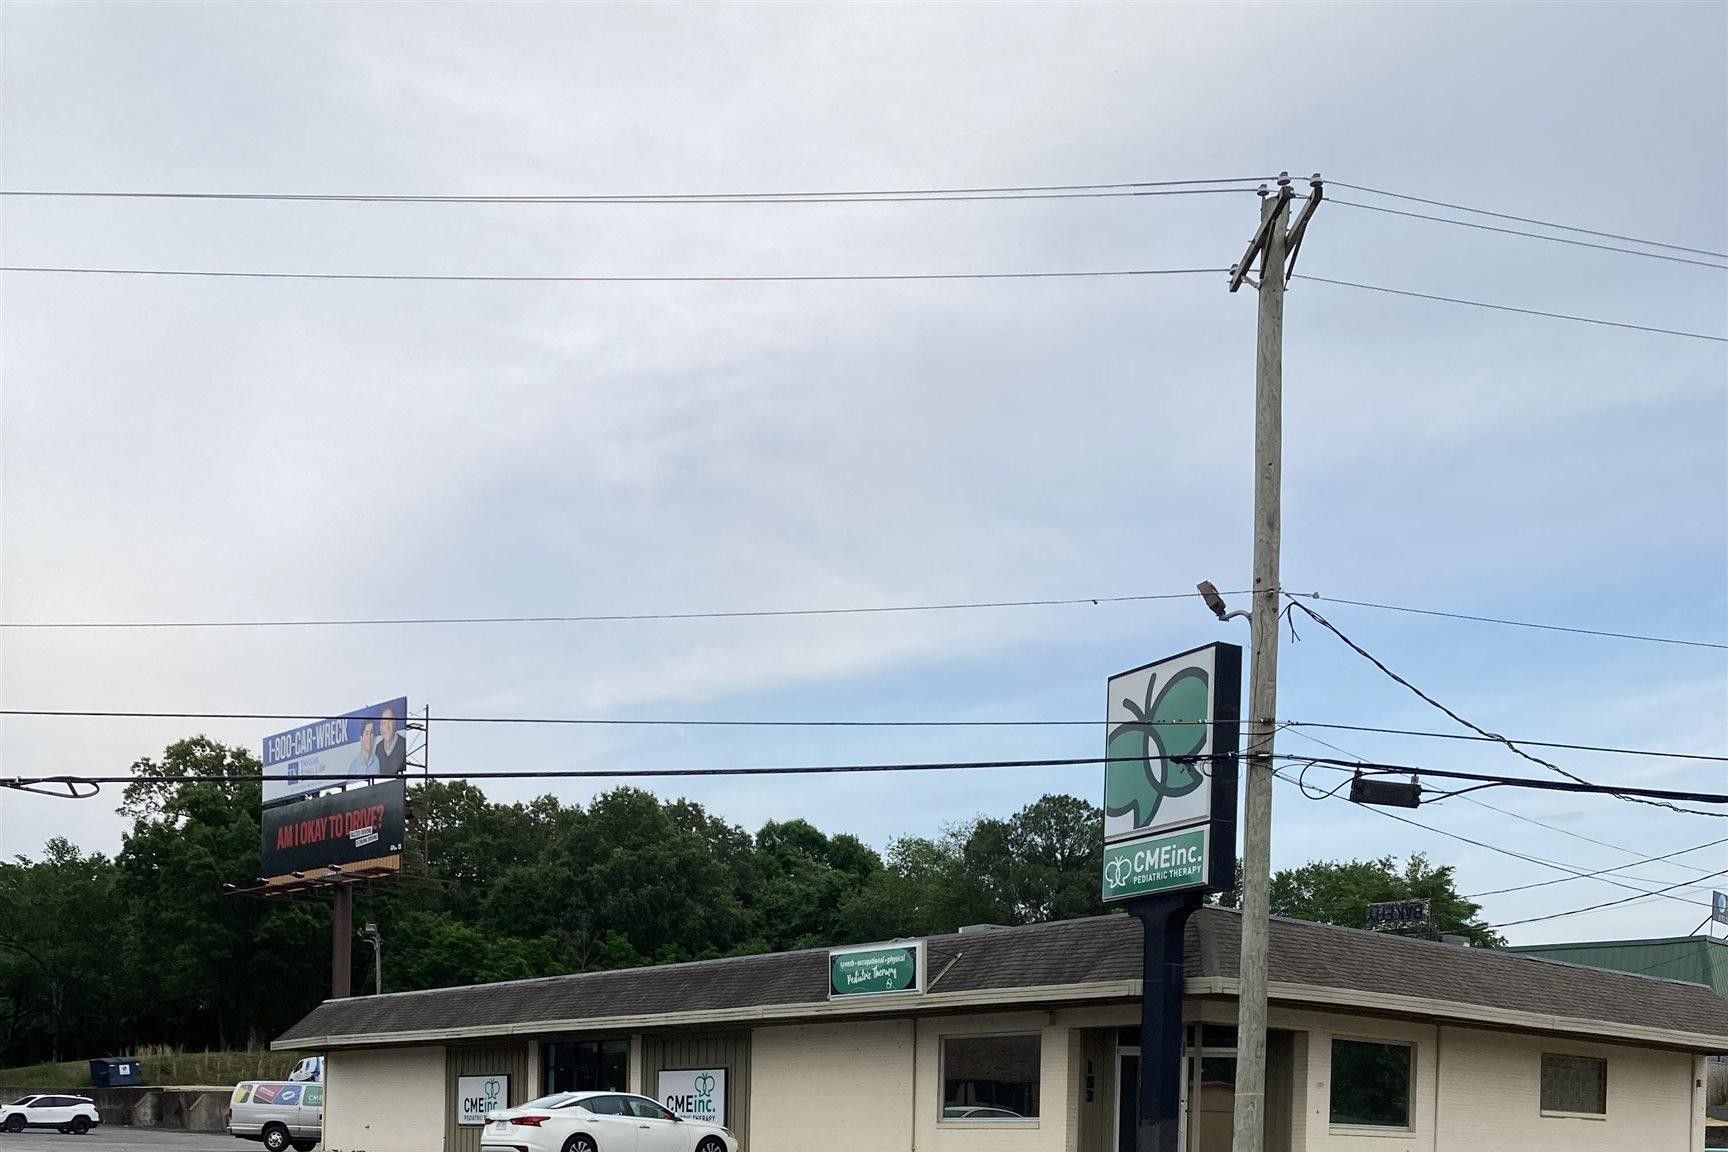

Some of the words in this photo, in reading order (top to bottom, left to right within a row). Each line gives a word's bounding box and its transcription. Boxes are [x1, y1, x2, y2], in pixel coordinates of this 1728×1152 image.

[268, 718, 348, 763] 1-800-CAR-WRECK
[276, 824, 293, 850] AM
[294, 823, 299, 846] I
[300, 816, 327, 845] OKAY
[328, 813, 343, 839] TO
[346, 804, 384, 835] DRIVE?
[1133, 844, 1202, 873] CMEinc.
[1133, 870, 1168, 885] PEDIATRIC
[1169, 865, 1202, 878] THERAPY
[872, 964, 897, 979] Therapy
[666, 1094, 716, 1113] CMEinc.
